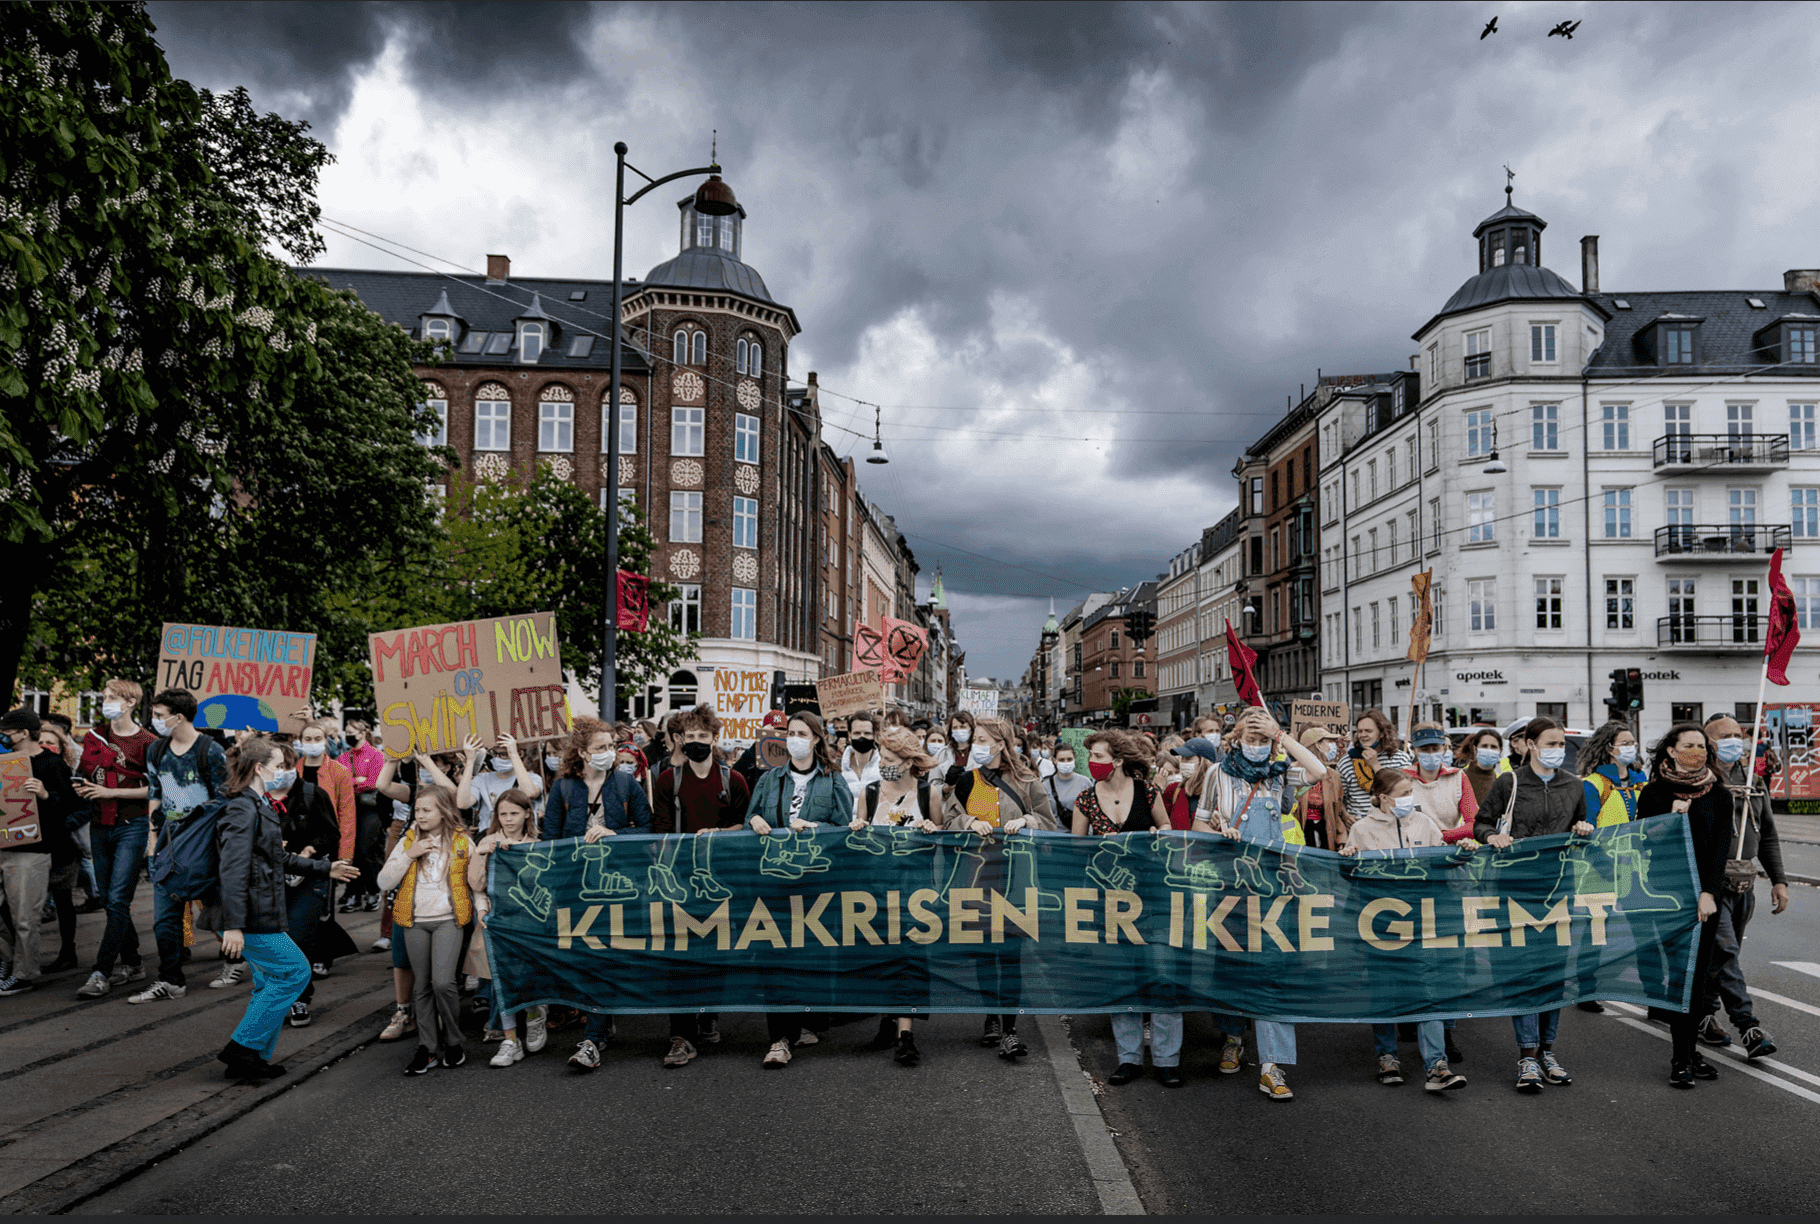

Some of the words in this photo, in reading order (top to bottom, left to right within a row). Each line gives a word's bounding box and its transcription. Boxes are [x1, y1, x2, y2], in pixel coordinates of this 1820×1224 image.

[164, 625, 315, 666] @FOLKETINGET
[374, 623, 479, 682] MARCH
[494, 616, 555, 663] NOW
[162, 658, 205, 690] TAG
[205, 661, 312, 699] ANSVAR!
[454, 668, 485, 697] OR
[715, 670, 738, 692] NO
[818, 669, 877, 692] PERMAKULTUR
[1456, 669, 1504, 683] apotek
[1640, 670, 1681, 681] potek
[717, 693, 766, 714] EMPTY
[1294, 704, 1341, 718] MEDIERNE
[382, 689, 478, 759] SWIM
[556, 887, 1039, 952] KLIMAKRISEN
[1063, 887, 1149, 946] ER
[1168, 891, 1336, 953] IKKE
[1357, 891, 1617, 951] GLEMT
